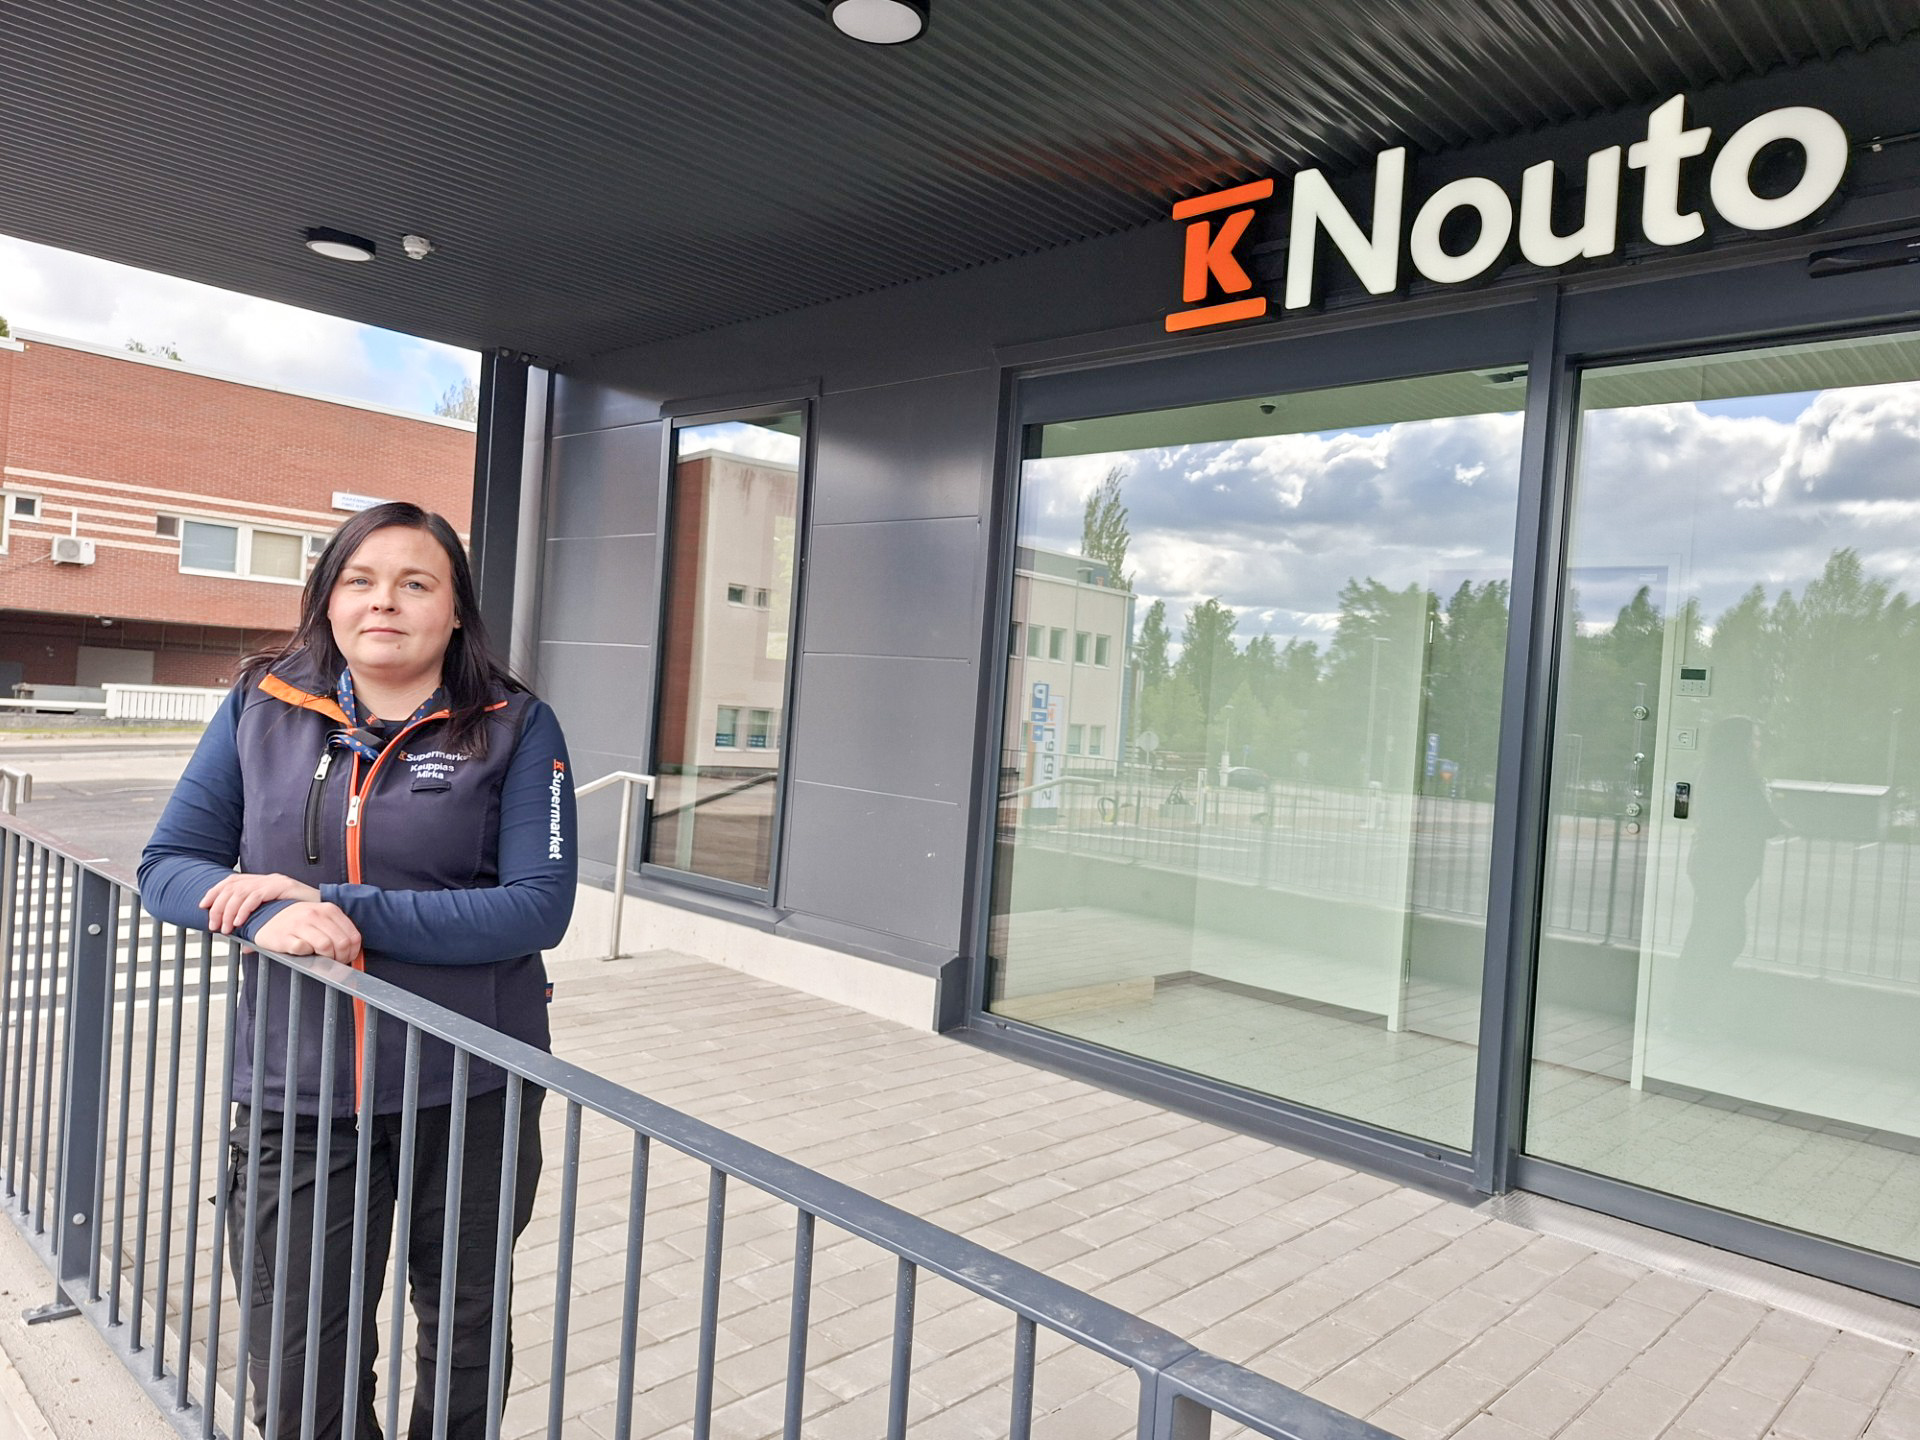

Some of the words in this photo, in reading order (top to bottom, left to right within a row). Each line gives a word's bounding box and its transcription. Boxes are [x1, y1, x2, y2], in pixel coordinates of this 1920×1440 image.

[1284, 93, 1848, 310] Nouto
[410, 763, 455, 772] Kauppias
[416, 770, 444, 780] Mirka
[549, 770, 564, 860] Supermarket
